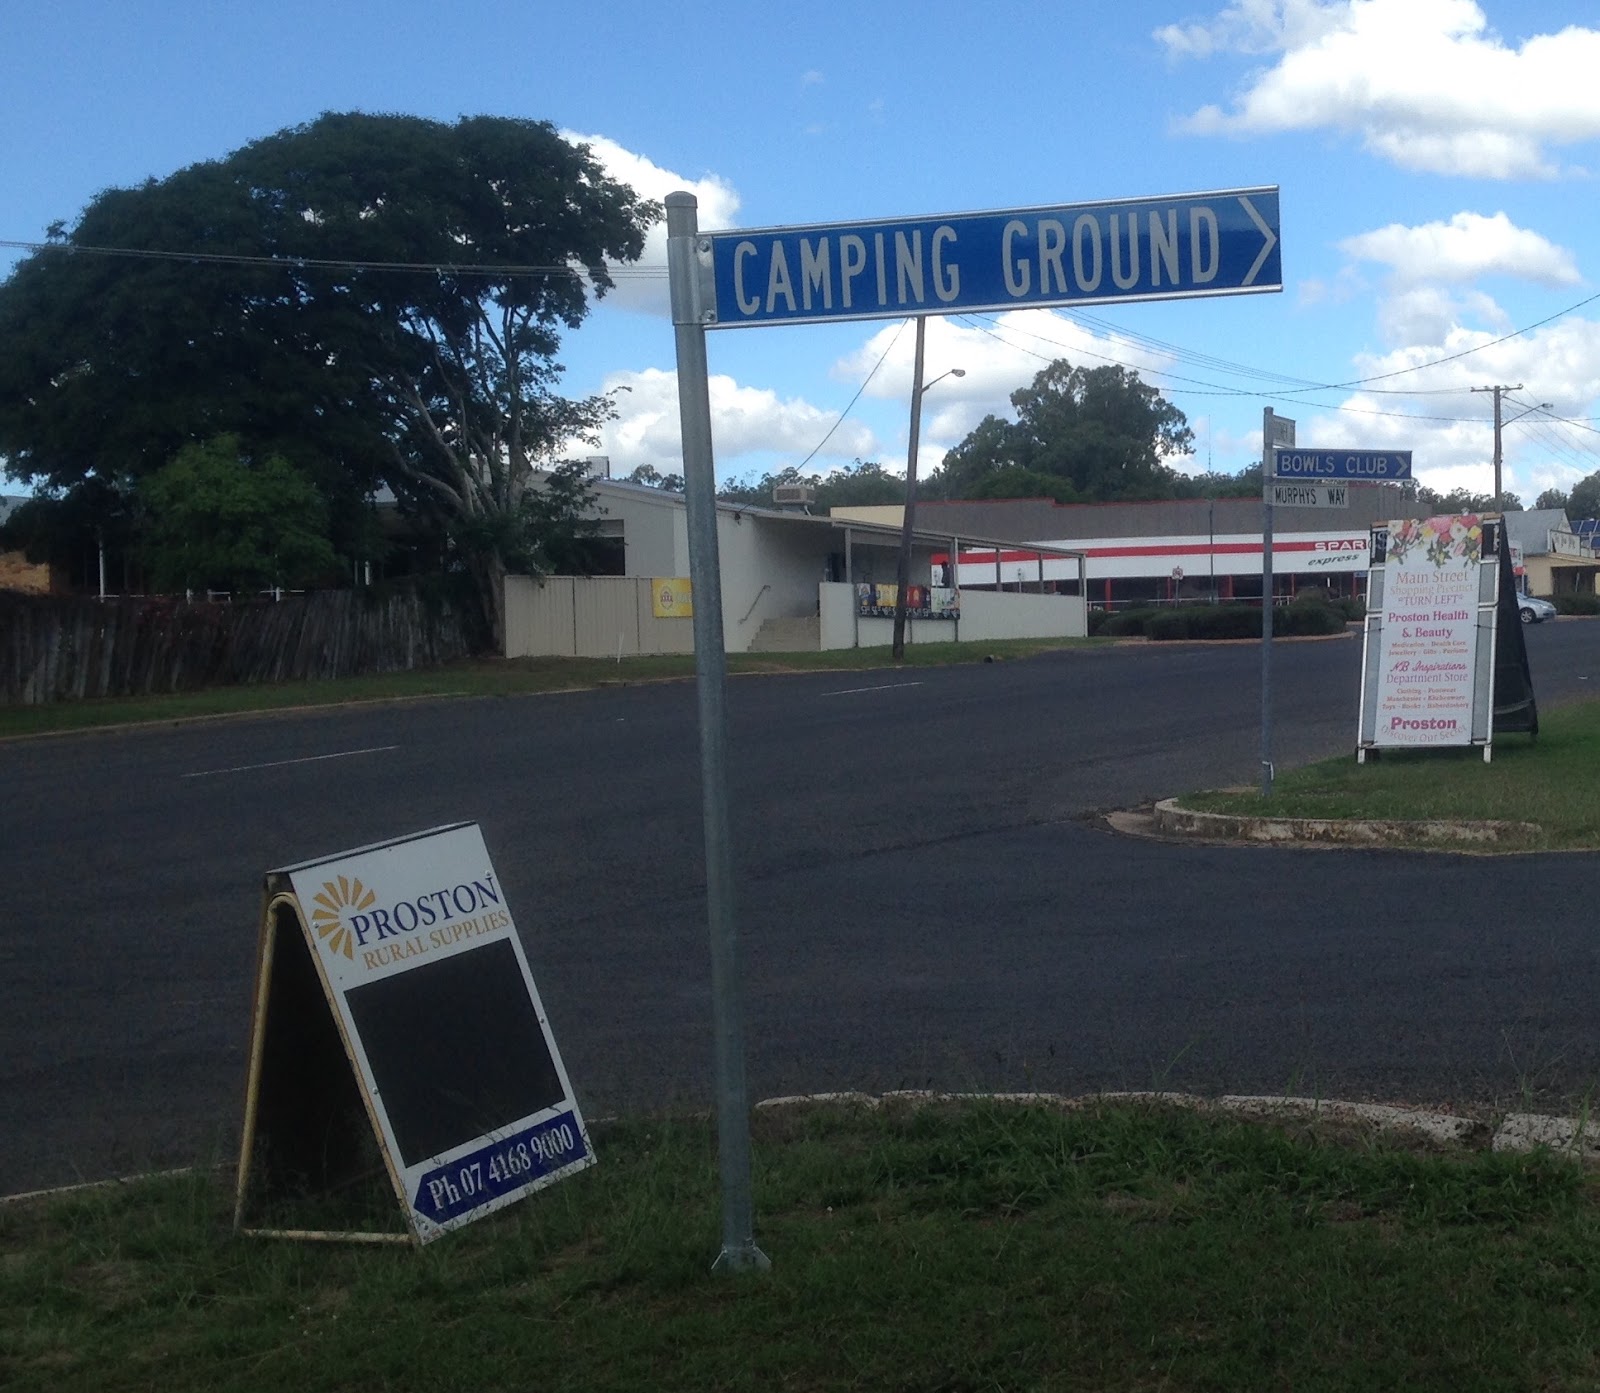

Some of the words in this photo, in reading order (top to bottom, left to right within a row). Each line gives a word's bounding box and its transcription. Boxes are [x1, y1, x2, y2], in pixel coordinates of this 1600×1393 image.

[734, 225, 960, 315] CAMPING
[1002, 207, 1220, 297] GROUND
[1281, 455, 1335, 473] BOWLS
[1346, 456, 1387, 474] CLUB
[1275, 488, 1316, 504] MURPHYS
[1328, 490, 1345, 505] WAY
[1315, 541, 1364, 551] SPAR
[1308, 554, 1359, 566] express
[1396, 572, 1429, 584] Main
[1432, 569, 1468, 583] Street
[1391, 585, 1434, 597] Shopping
[1388, 612, 1429, 622] Proston
[1433, 610, 1469, 620] Health
[1402, 627, 1412, 638] &
[1415, 627, 1453, 639] Beauty
[1412, 660, 1468, 673] Inspirations
[1386, 673, 1442, 685] Department
[1444, 672, 1469, 682] Store
[1391, 716, 1457, 730] Proston
[1419, 733, 1438, 743] Our
[348, 876, 500, 947] PROSTON
[363, 936, 429, 970] RURAL
[429, 909, 510, 949] SUPPLIES
[427, 1175, 461, 1211] Ph
[460, 1163, 482, 1196] 07
[489, 1143, 531, 1183] 4168
[530, 1123, 574, 1164] 9000
